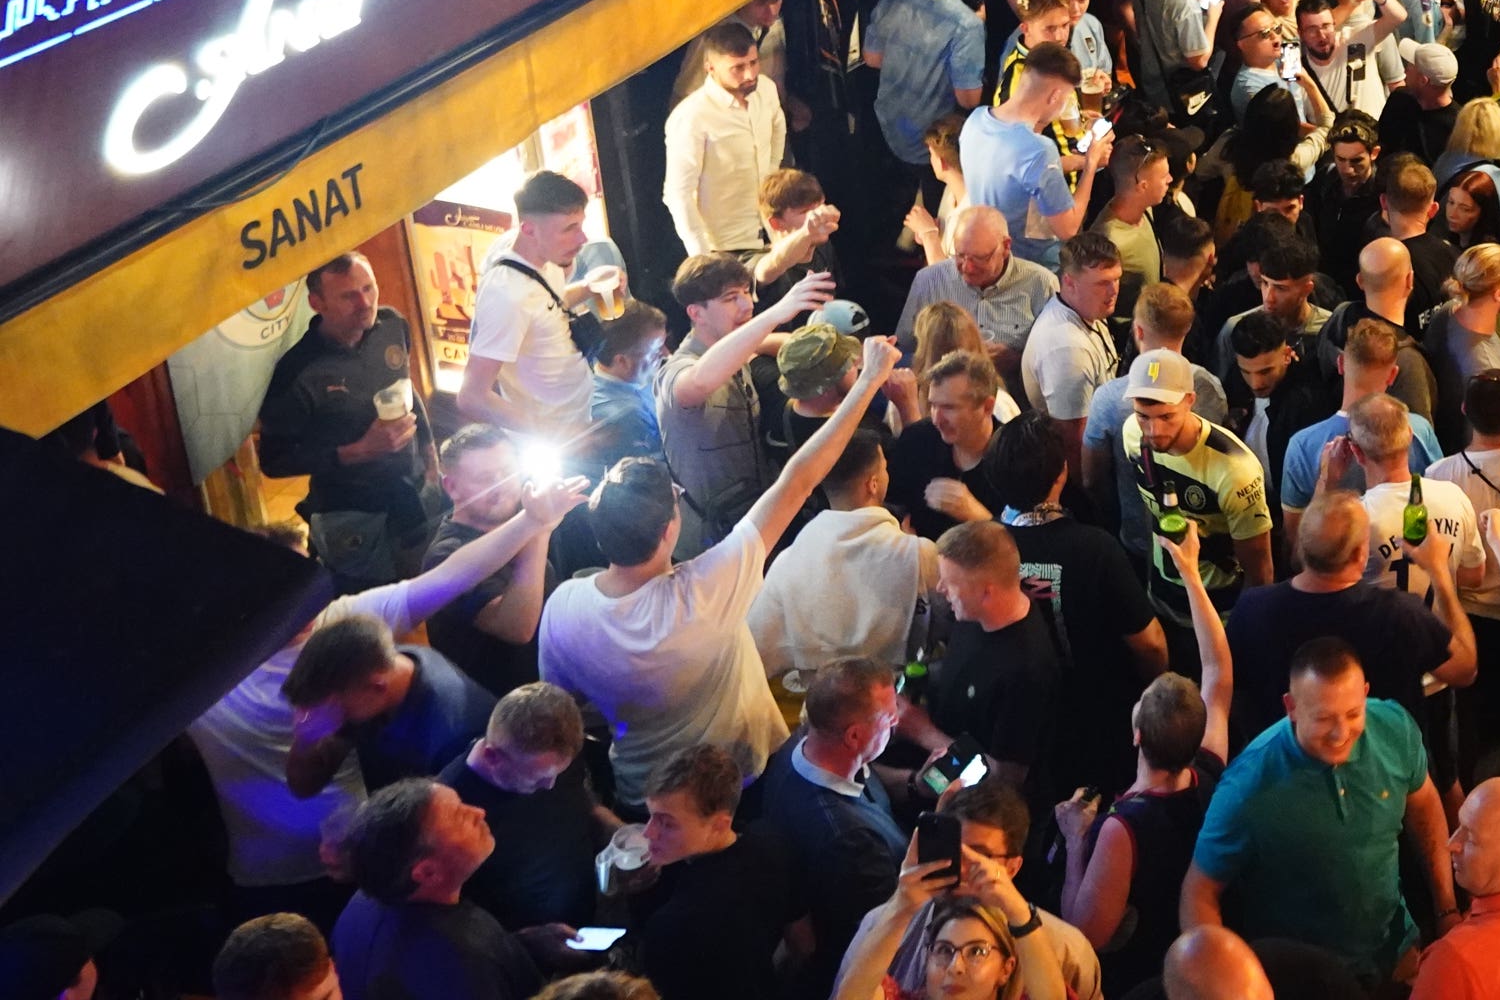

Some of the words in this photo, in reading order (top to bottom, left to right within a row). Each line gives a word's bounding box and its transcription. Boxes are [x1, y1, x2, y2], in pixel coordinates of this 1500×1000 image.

[241, 163, 363, 270] SANAT
[261, 313, 292, 340] CITY
[1236, 475, 1262, 500] NEXEN
[1378, 535, 1399, 559] DE
